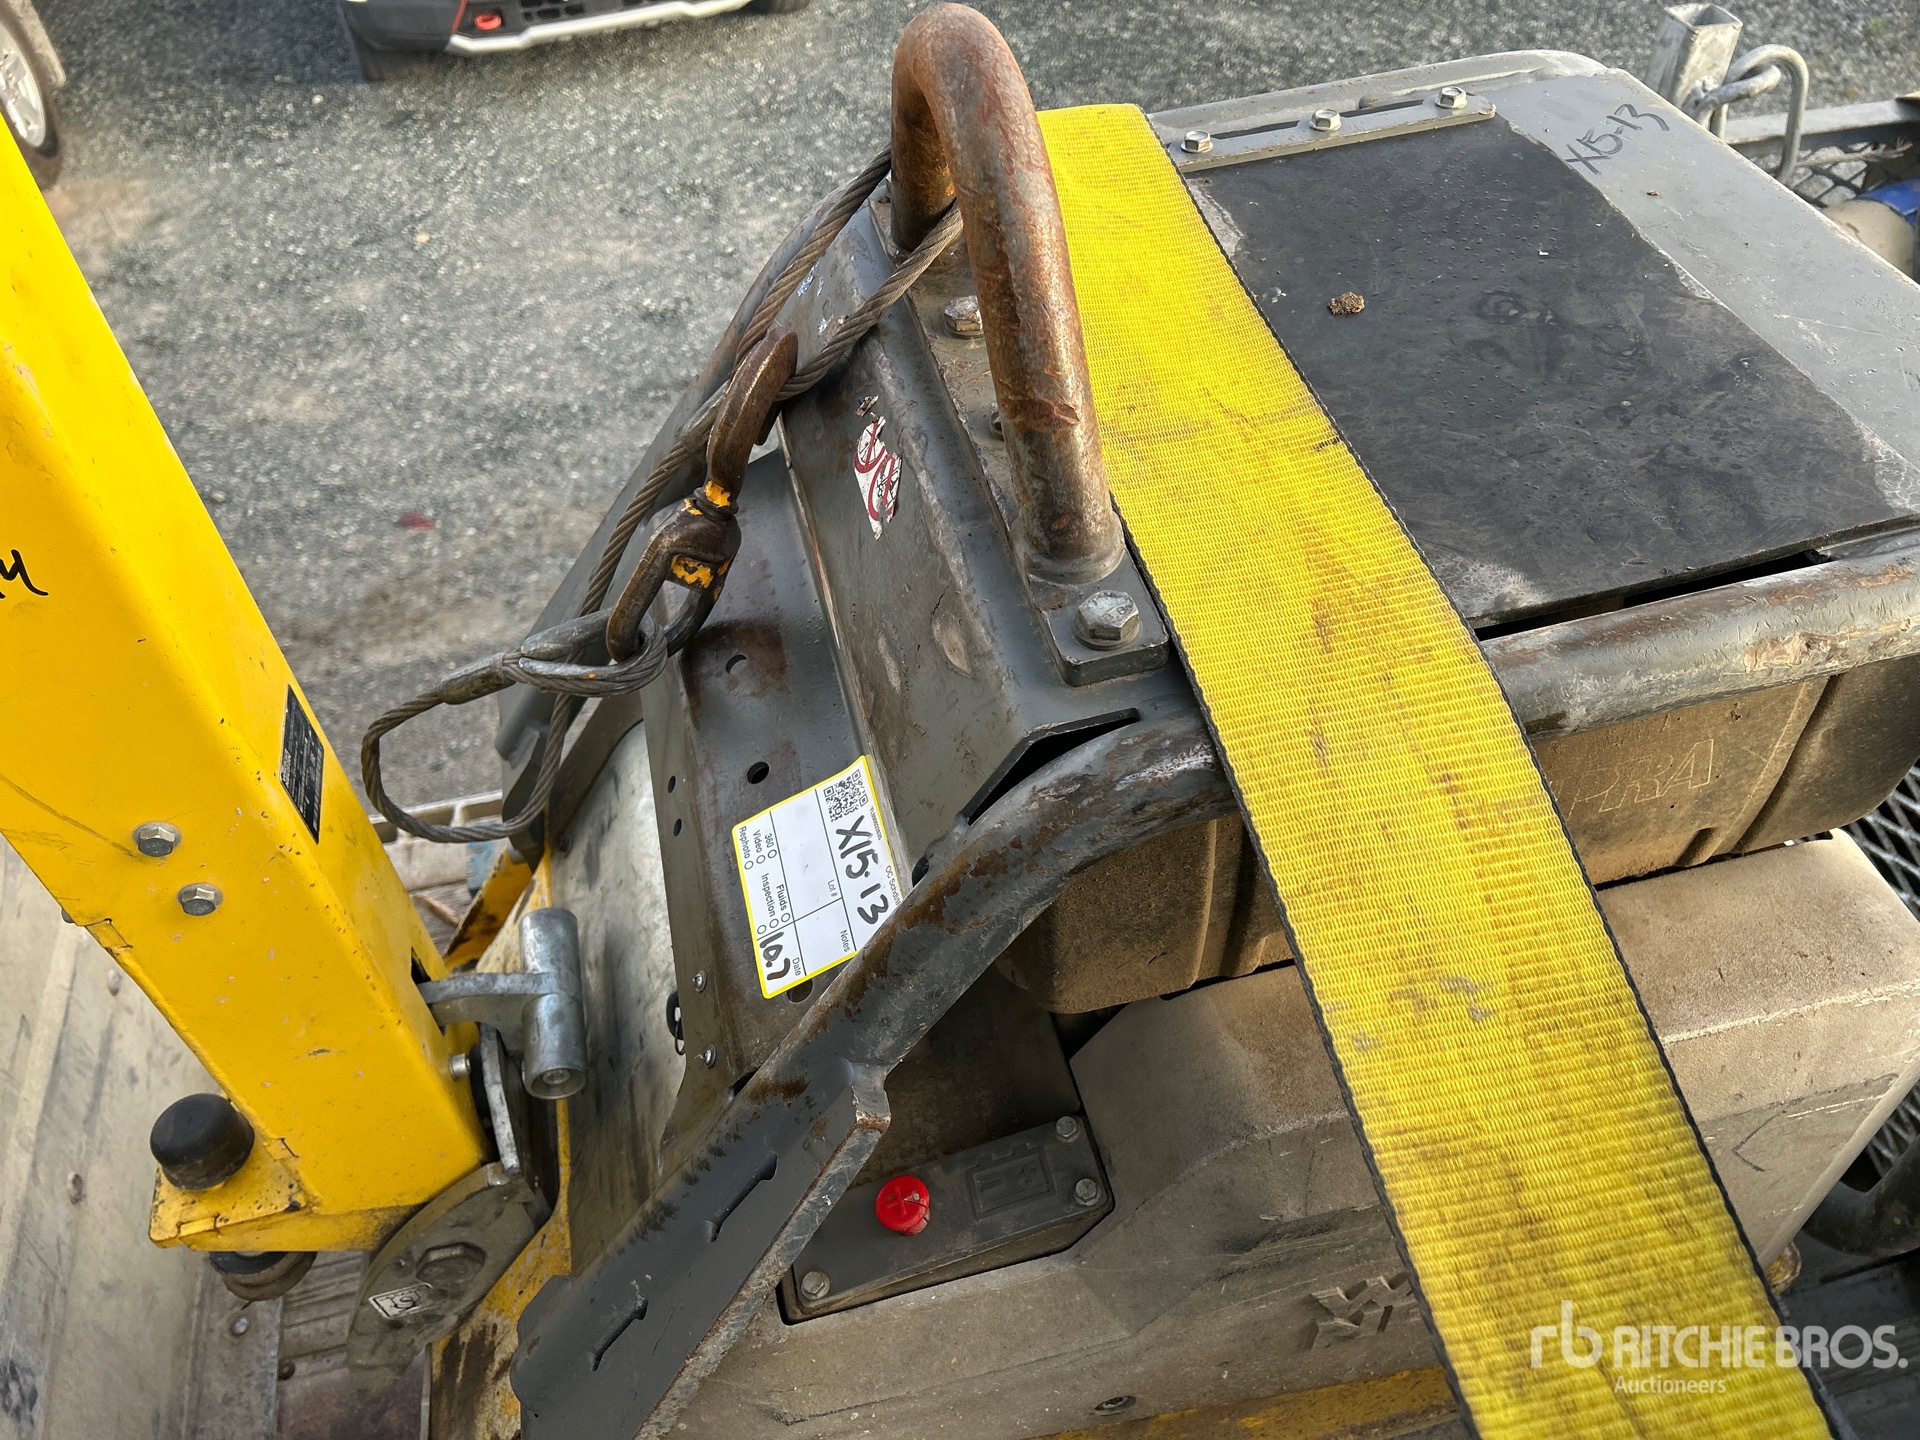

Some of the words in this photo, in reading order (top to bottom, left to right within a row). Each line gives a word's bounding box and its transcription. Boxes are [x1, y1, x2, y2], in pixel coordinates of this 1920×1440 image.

[739, 826, 751, 859] Rephoto
[752, 829, 763, 855] Video
[764, 833, 774, 848] 360
[761, 872, 776, 918] Inspection
[776, 884, 788, 911] Fluids
[827, 880, 836, 893] Lot
[839, 930, 850, 952] Notes
[791, 957, 802, 976] Date
